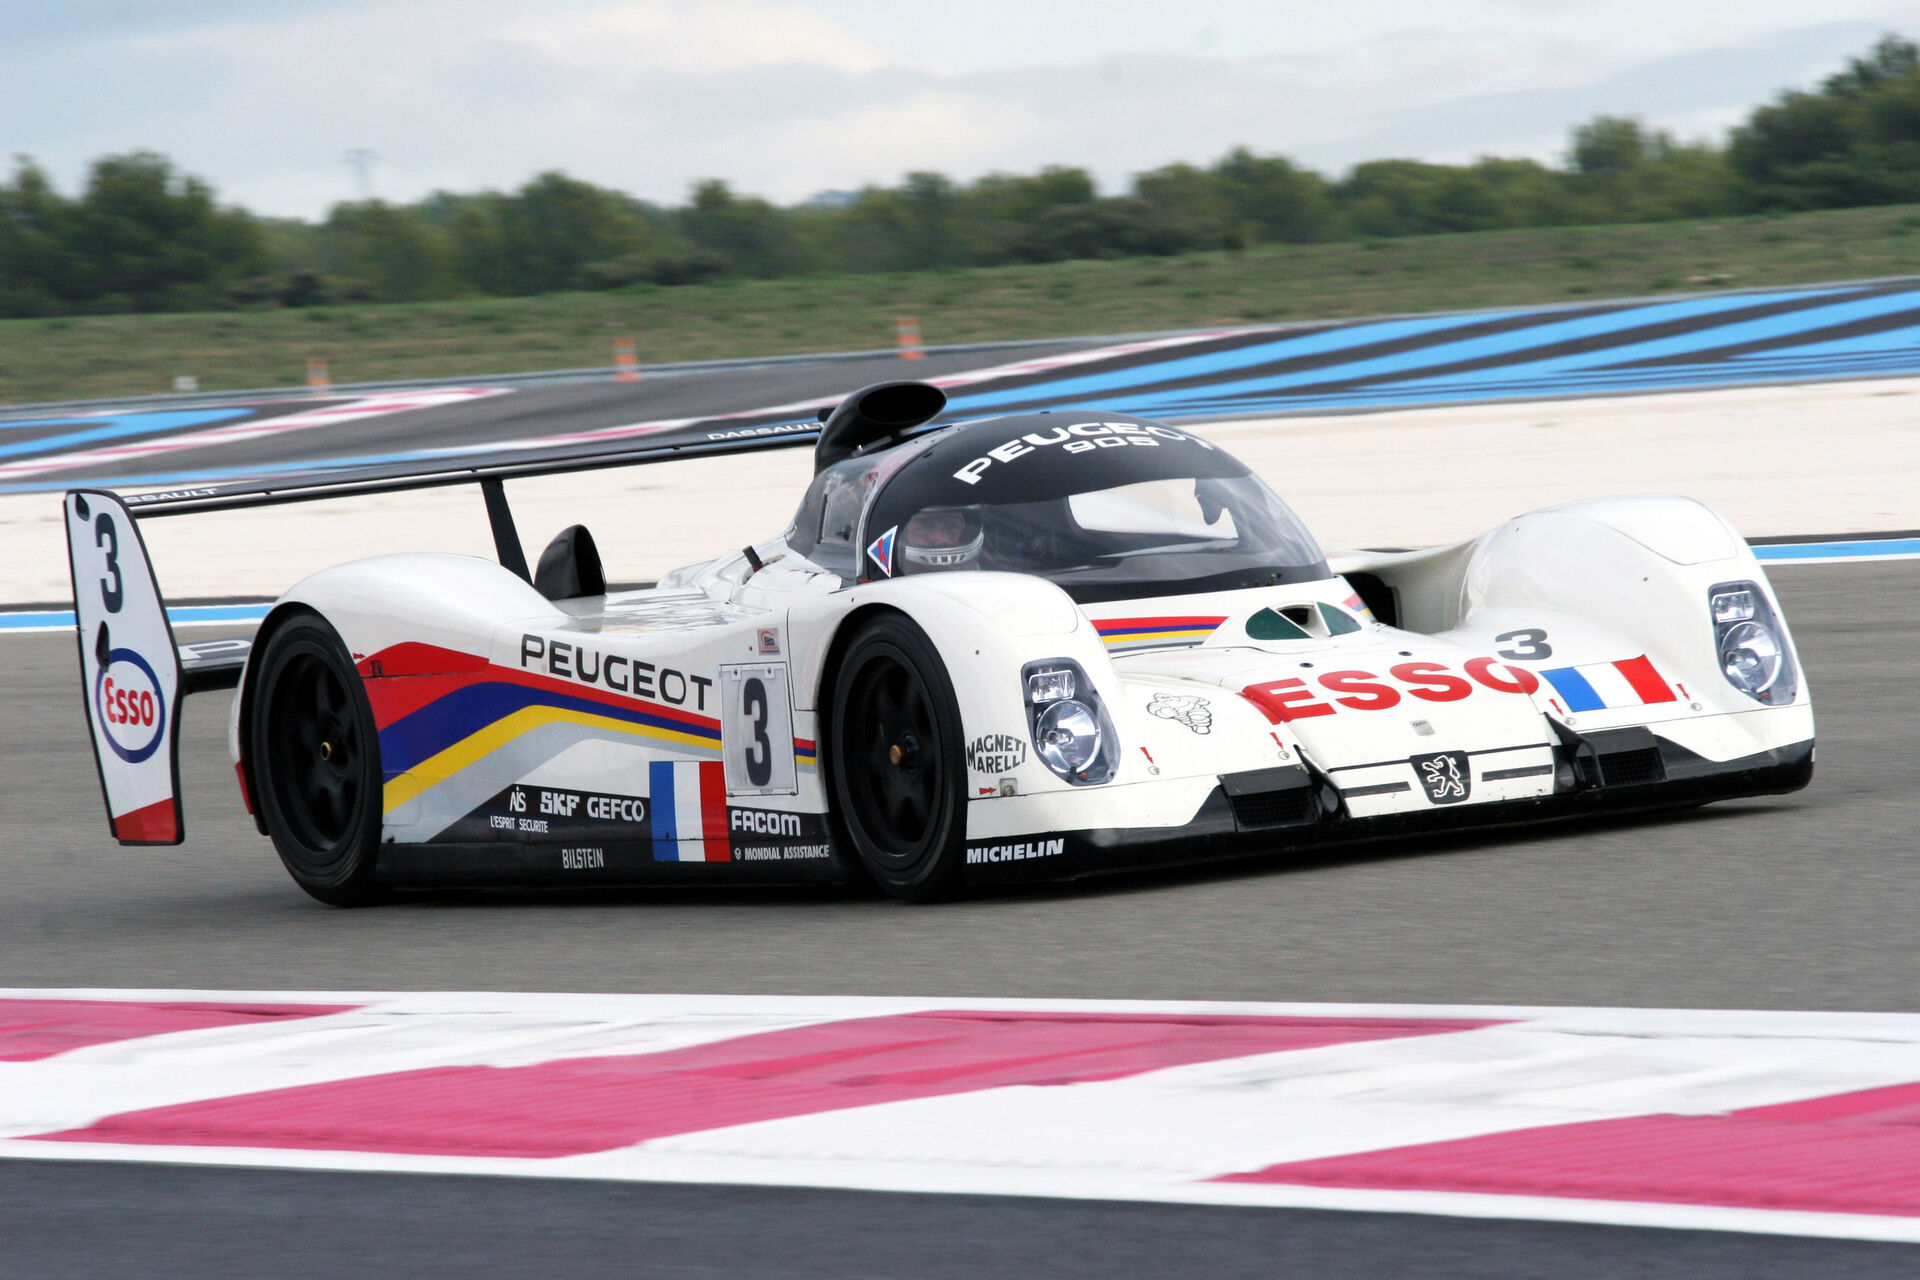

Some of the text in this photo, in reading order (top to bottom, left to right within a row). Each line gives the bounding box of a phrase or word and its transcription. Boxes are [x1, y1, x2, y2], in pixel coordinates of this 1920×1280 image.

[952, 421, 1215, 486] PEUGEOT
[1063, 435, 1160, 454] 905
[95, 513, 124, 614] 3
[1495, 628, 1553, 660] 3
[521, 633, 713, 711] PEUGEOT
[1238, 656, 1540, 725] ESSO
[743, 677, 773, 787] 3
[966, 734, 1026, 763] MAGNETI
[966, 749, 1026, 774] MARELLI
[540, 791, 580, 817] SKF
[587, 797, 645, 823] GEFCO
[490, 815, 549, 834] L'ESPRIT SECURITE
[731, 809, 801, 837] FACOM
[562, 848, 605, 869] BILSTEIN
[744, 845, 830, 861] MONDIAL ASSISTANCE
[966, 838, 1065, 864] MICHELIN
